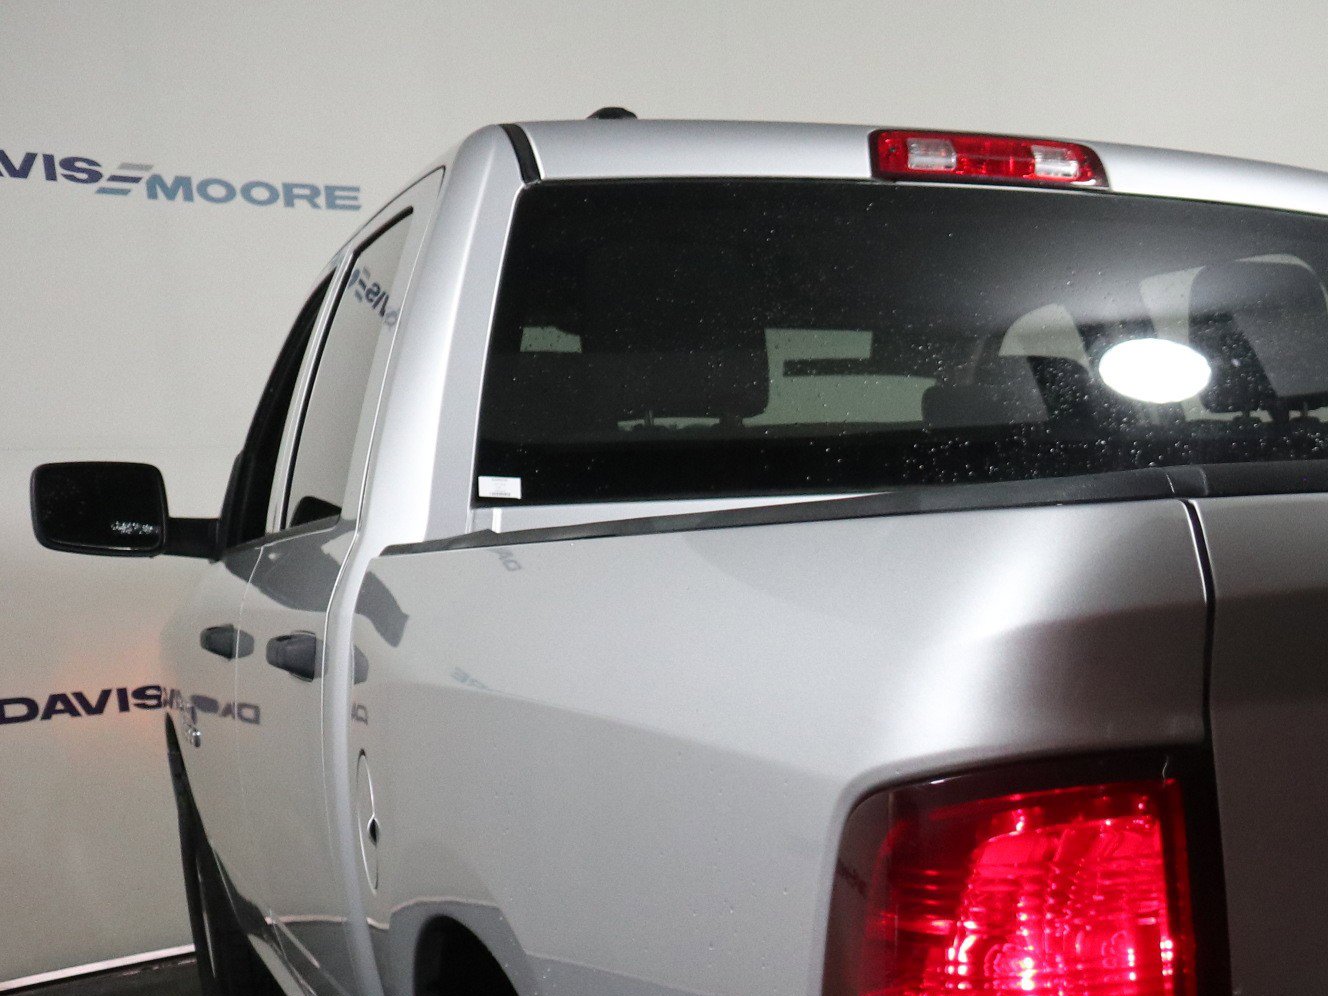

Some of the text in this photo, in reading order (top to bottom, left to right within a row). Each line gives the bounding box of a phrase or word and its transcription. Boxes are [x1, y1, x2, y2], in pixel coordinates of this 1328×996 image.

[0, 148, 362, 212] VIS MOORE
[0, 684, 165, 724] DAVIS
